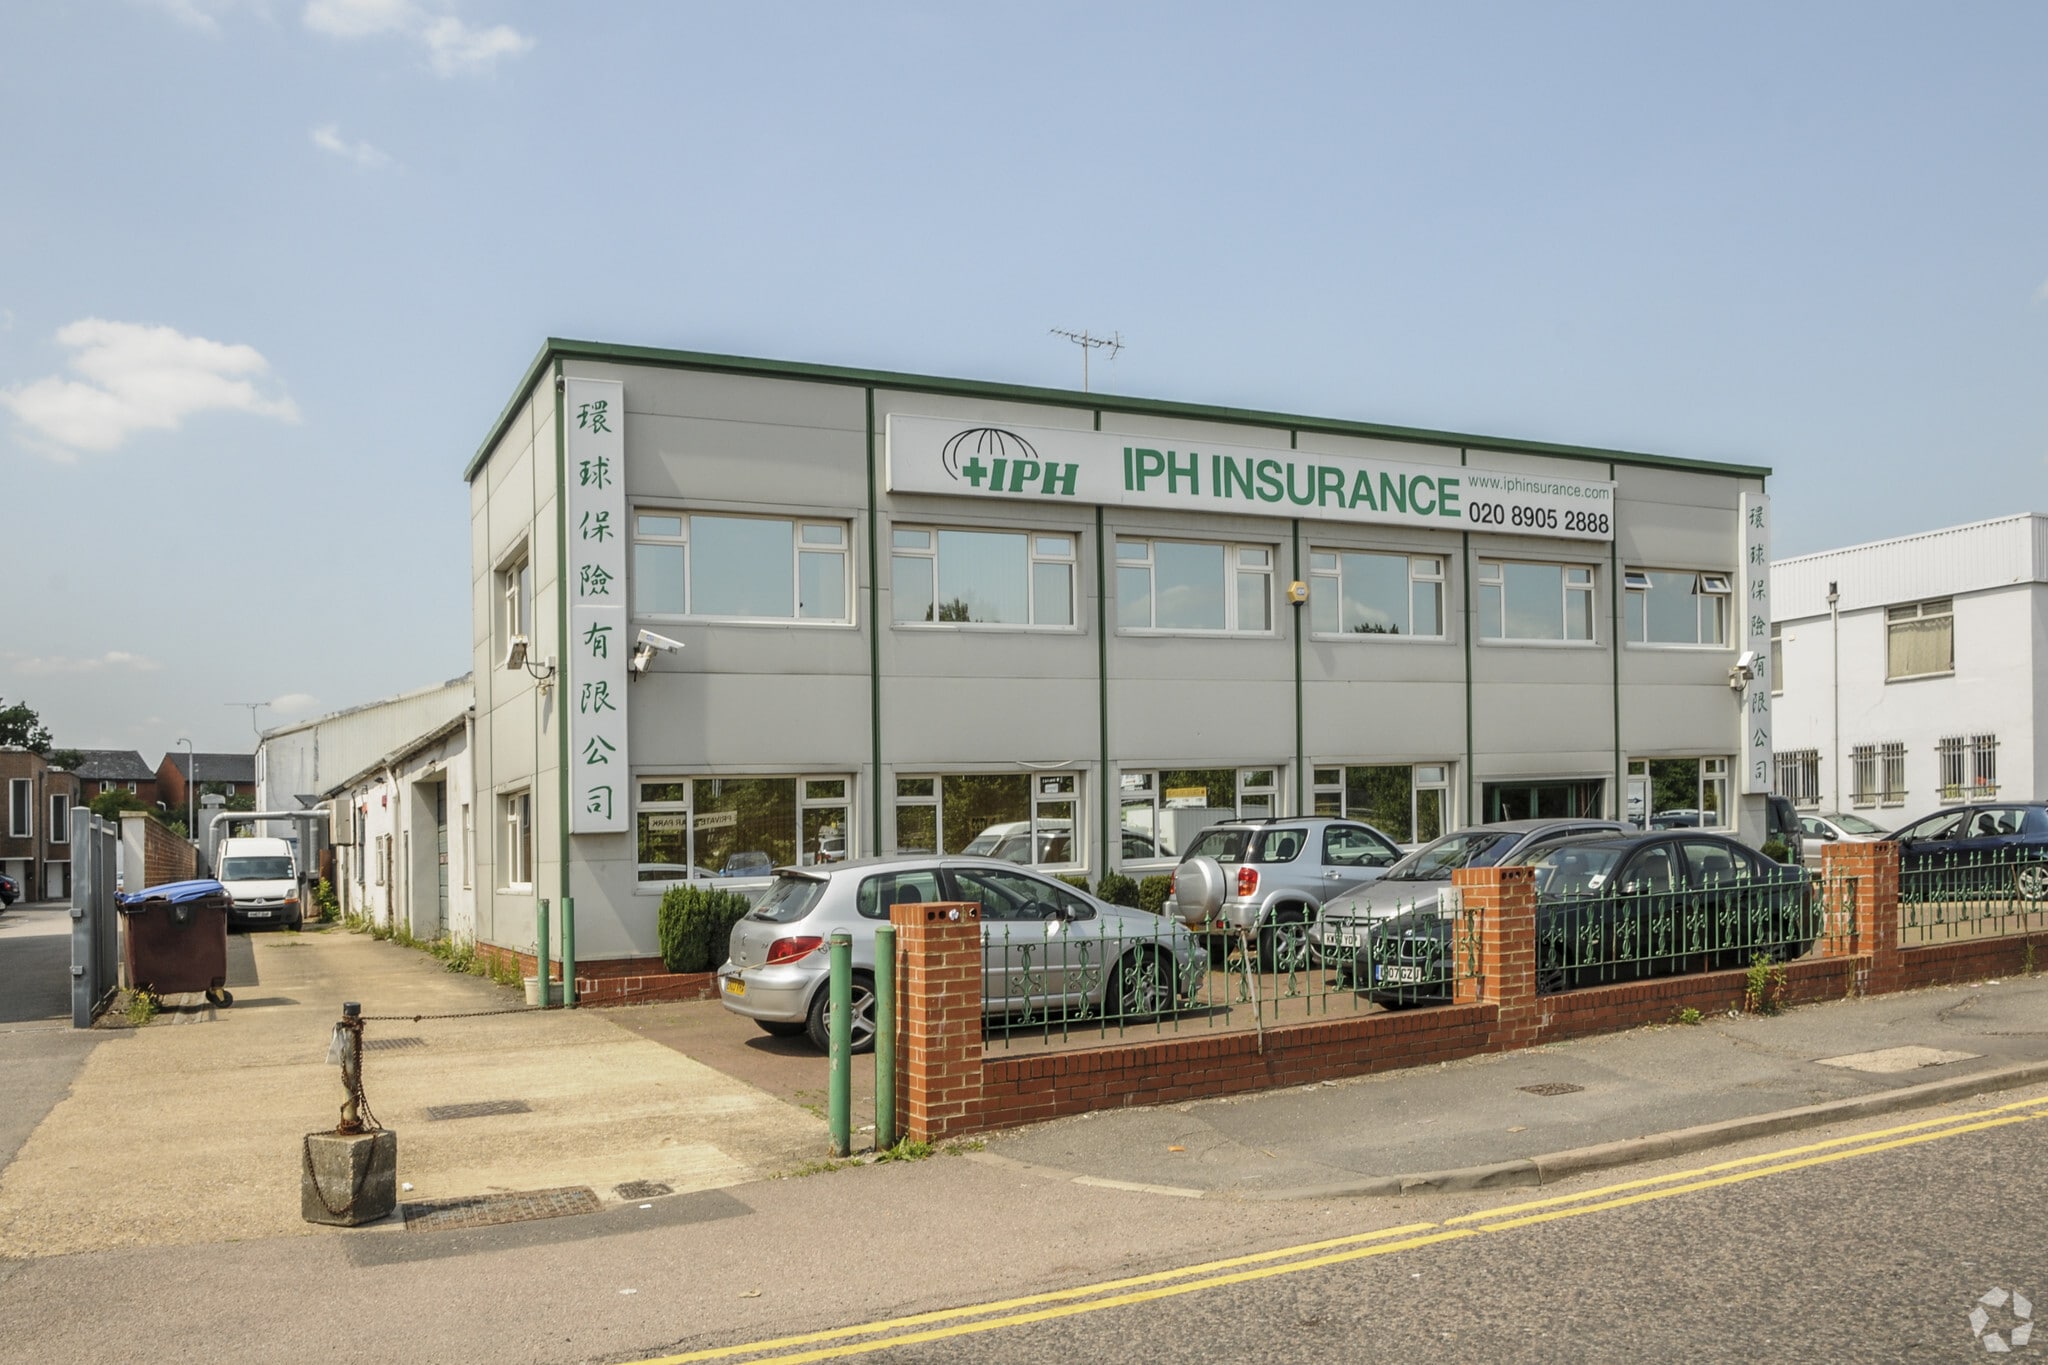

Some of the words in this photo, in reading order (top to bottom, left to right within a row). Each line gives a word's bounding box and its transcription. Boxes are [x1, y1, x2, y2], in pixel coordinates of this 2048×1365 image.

[988, 457, 1080, 496] IPH
[1123, 447, 1200, 496] IPH
[1211, 454, 1462, 517] INSURANCE
[1468, 475, 1610, 500] www.iphinsurance.com
[1468, 501, 1505, 525] 020
[1511, 505, 1558, 530] 8905
[1564, 510, 1610, 534] 2888
[576, 399, 617, 820] 環球保險有限公司
[1749, 507, 1768, 784] 環球保險有限公司
